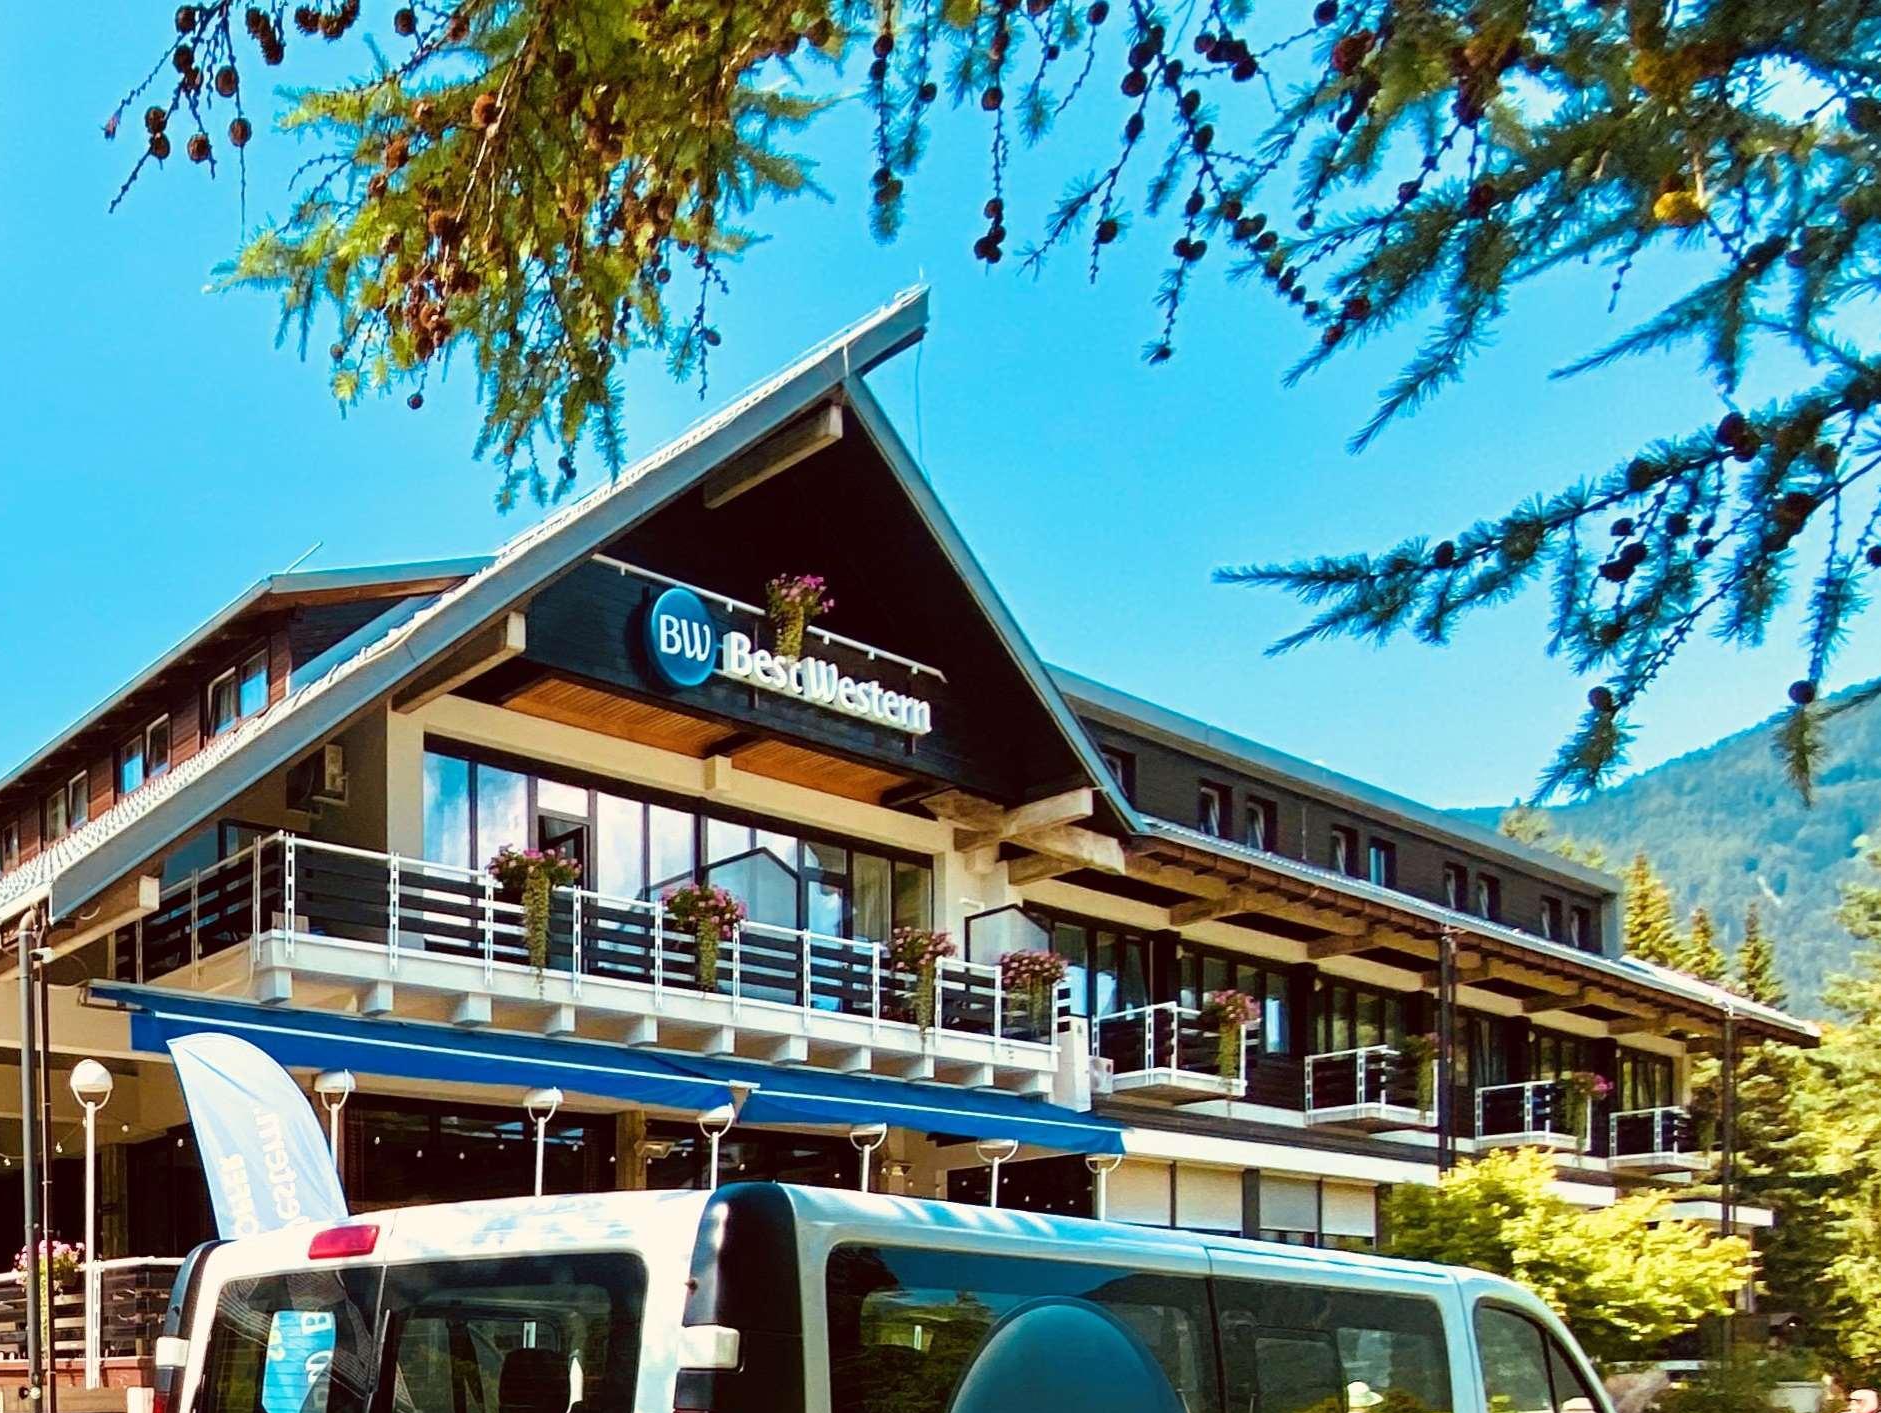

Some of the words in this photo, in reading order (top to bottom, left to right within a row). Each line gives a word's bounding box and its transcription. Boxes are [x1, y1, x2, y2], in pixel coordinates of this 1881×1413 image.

[659, 614, 711, 662] BW
[722, 632, 804, 692] Best
[801, 657, 932, 734] Western
